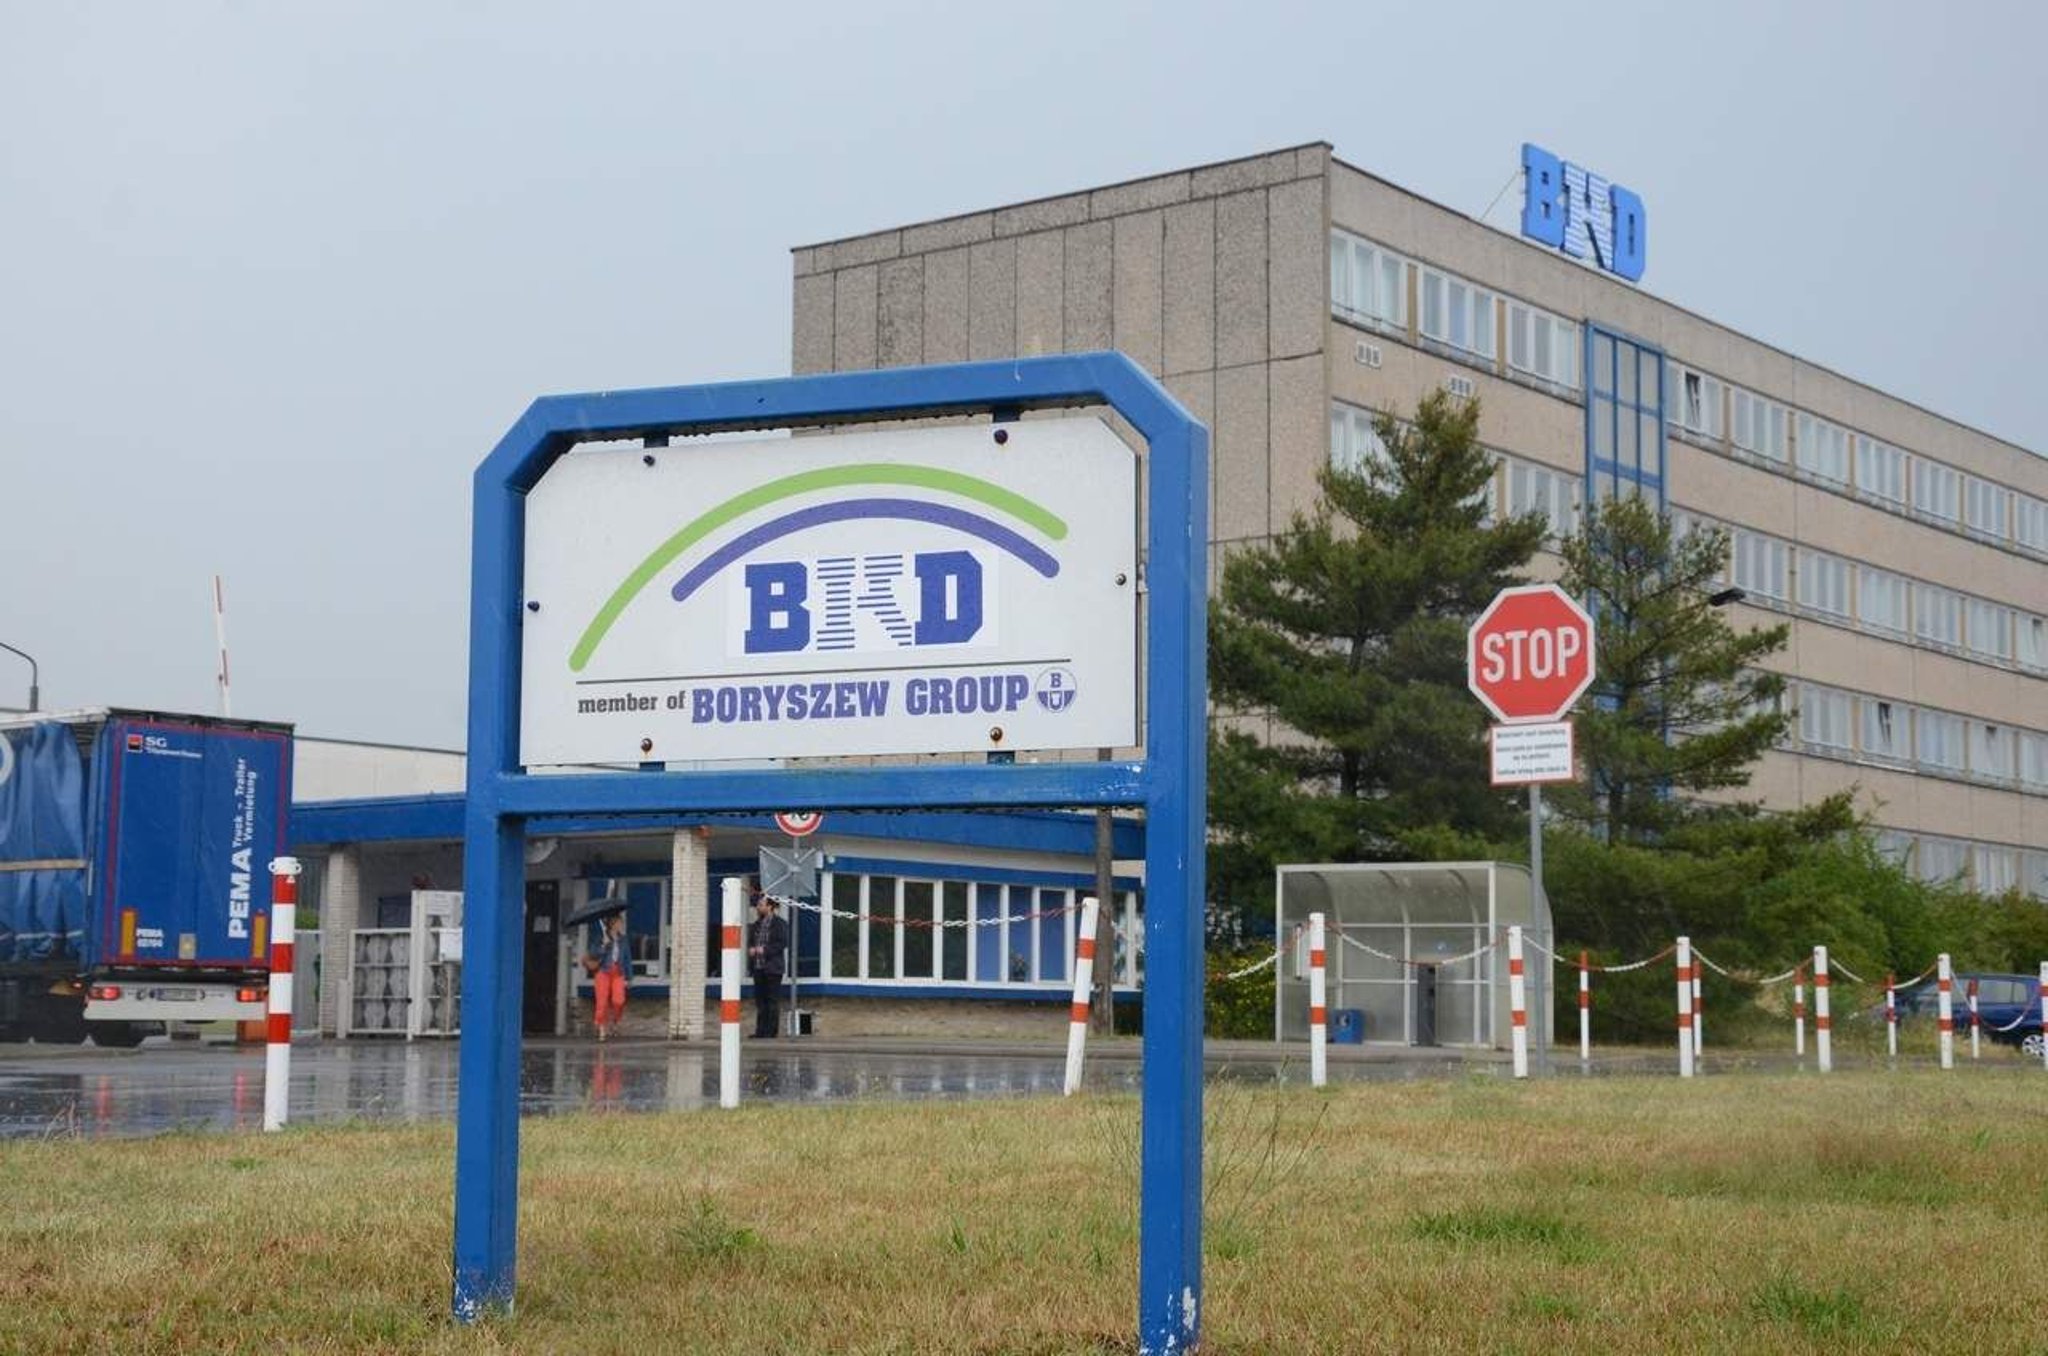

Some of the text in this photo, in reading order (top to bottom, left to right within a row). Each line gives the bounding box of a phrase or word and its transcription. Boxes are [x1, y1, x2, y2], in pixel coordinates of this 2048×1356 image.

[1521, 142, 1645, 282] BKD
[744, 550, 983, 654] BKD
[1482, 626, 1580, 683] STOP
[578, 674, 1030, 724] member of BORYSZEW GROUP
[145, 736, 168, 748] SG
[234, 758, 246, 797] Trailer
[232, 815, 244, 848] Truck
[228, 848, 252, 938] PEMA
